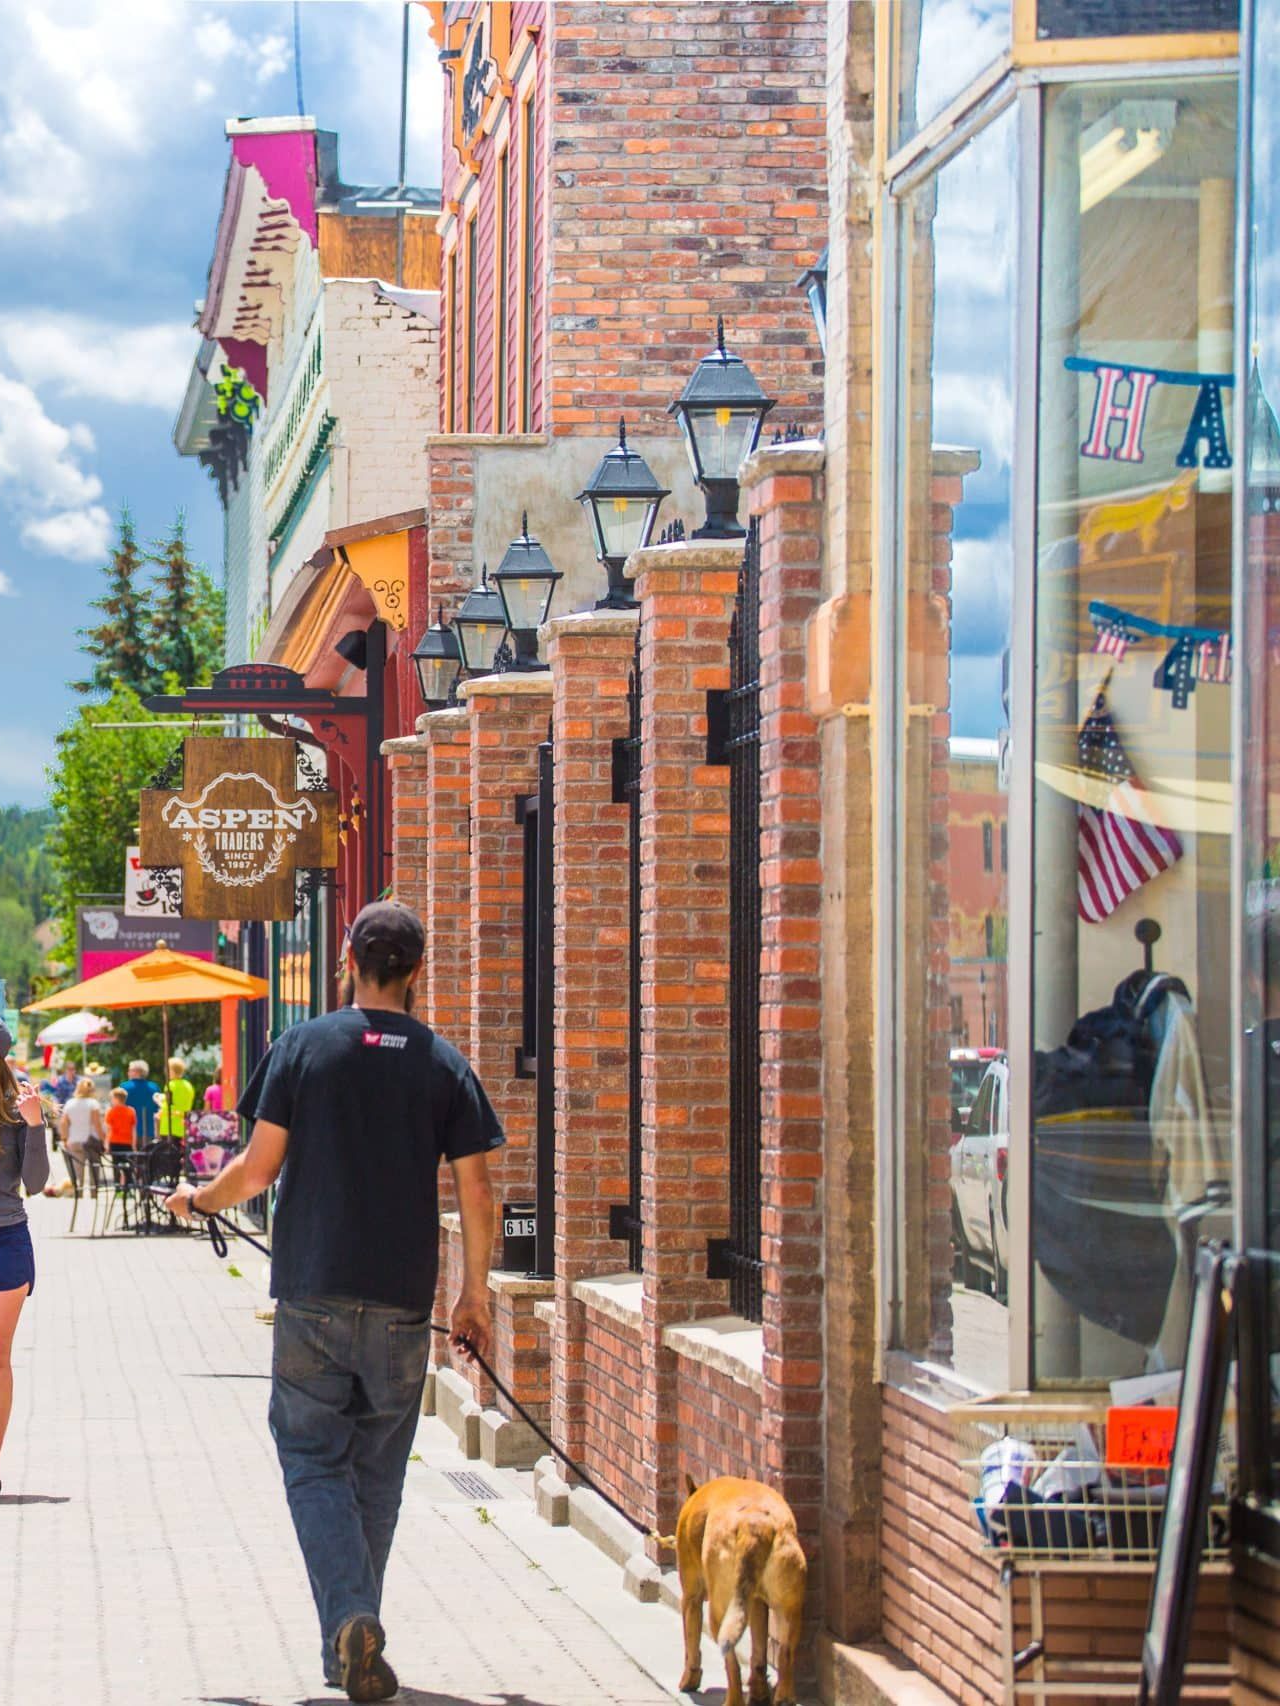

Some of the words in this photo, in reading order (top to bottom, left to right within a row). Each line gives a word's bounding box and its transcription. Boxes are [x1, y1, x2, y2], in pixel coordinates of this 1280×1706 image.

[169, 808, 306, 829] ASPEN
[214, 831, 264, 850] TRADERS
[223, 852, 255, 861] SINCE
[227, 861, 251, 869] 1987
[506, 1220, 535, 1236] 615
